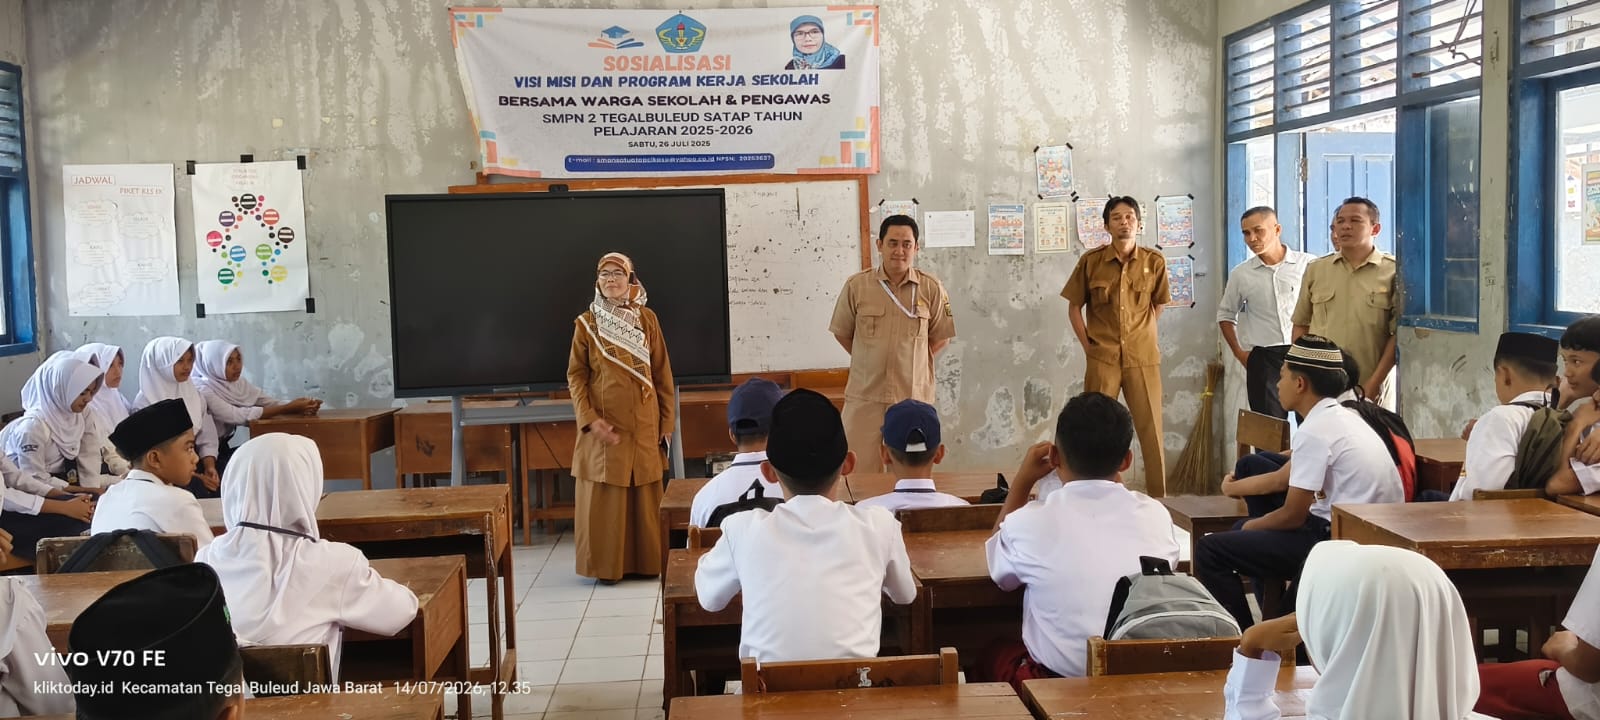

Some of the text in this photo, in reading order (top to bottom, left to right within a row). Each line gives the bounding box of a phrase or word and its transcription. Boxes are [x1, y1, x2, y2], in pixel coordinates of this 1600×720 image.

[603, 55, 731, 71] SOSIALISASI
[514, 73, 819, 88] VISI MISI DAN PROGRAM KERJA SEKOLAH
[499, 93, 831, 107] BERSAMA WARGA SEKOLAH & PENGAWAS
[542, 111, 802, 124] SMPN 2 TEGALBULEUD SATAP TAHUN
[593, 125, 753, 137] PELAJARAN 2025-2026
[74, 176, 113, 185] JADWAL
[119, 187, 139, 195] PIKET
